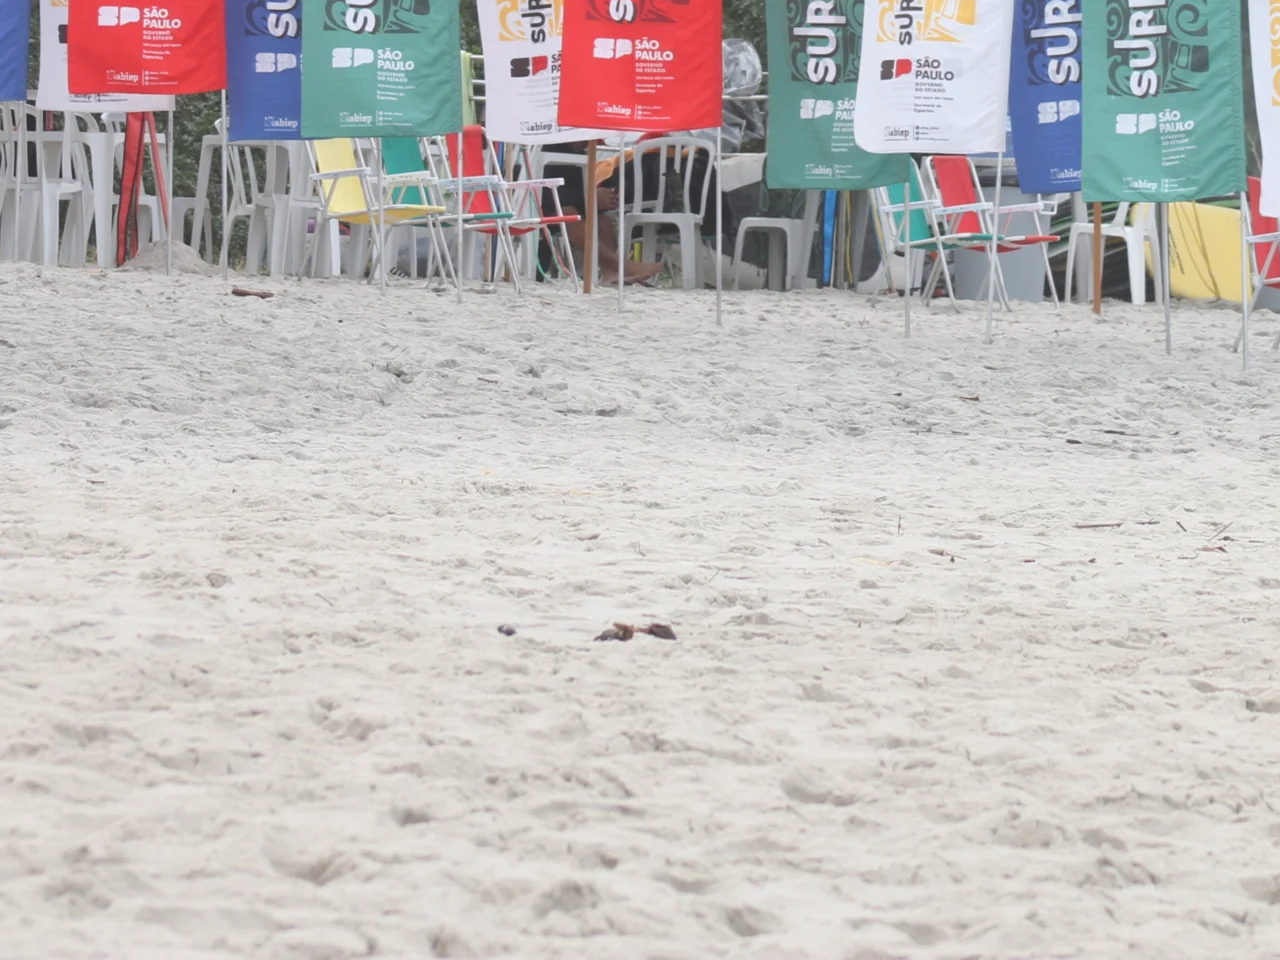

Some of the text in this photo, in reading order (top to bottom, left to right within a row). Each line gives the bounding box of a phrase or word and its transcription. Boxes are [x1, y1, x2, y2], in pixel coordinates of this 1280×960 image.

[143, 6, 168, 18] SÃO
[143, 19, 182, 29] PAULO
[635, 37, 659, 50] SÃO
[377, 48, 402, 60] SÃO
[551, 50, 562, 63] SÃ
[635, 50, 674, 61] PAULO
[377, 60, 414, 71] PAULO
[916, 56, 941, 69] SÃO
[915, 69, 954, 81] PAULO
[835, 111, 854, 120] PAU
[1158, 109, 1181, 122] SÃO
[1159, 120, 1195, 133] PAULO
